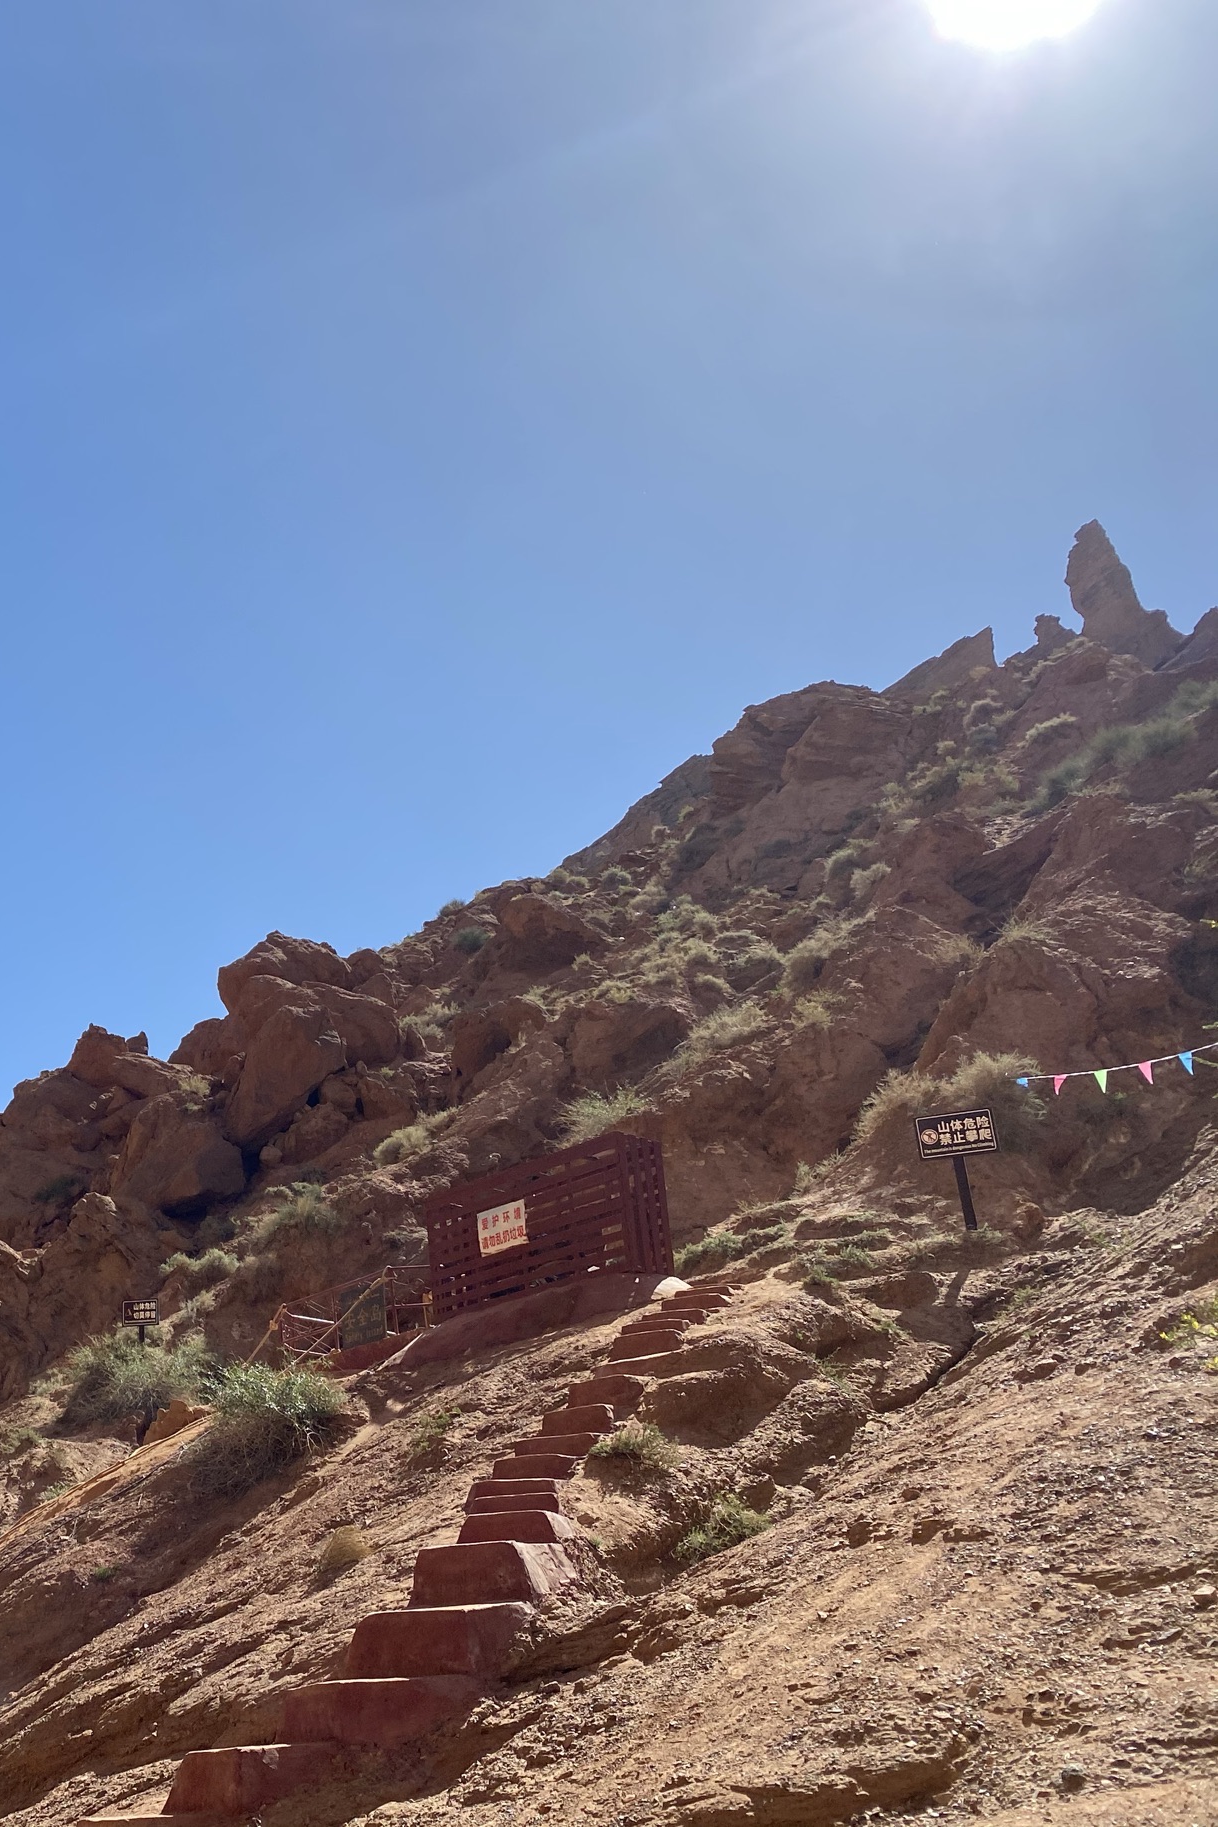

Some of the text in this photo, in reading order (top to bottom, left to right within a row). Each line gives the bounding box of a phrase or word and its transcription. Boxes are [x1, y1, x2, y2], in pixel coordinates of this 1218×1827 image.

[937, 1116, 990, 1133] 山体危险
[940, 1129, 992, 1145] 禁止攀爬
[481, 1207, 521, 1230] 爱护环境
[481, 1225, 526, 1249] 请勿乱扔垃圾
[133, 1302, 155, 1310] 山体危险
